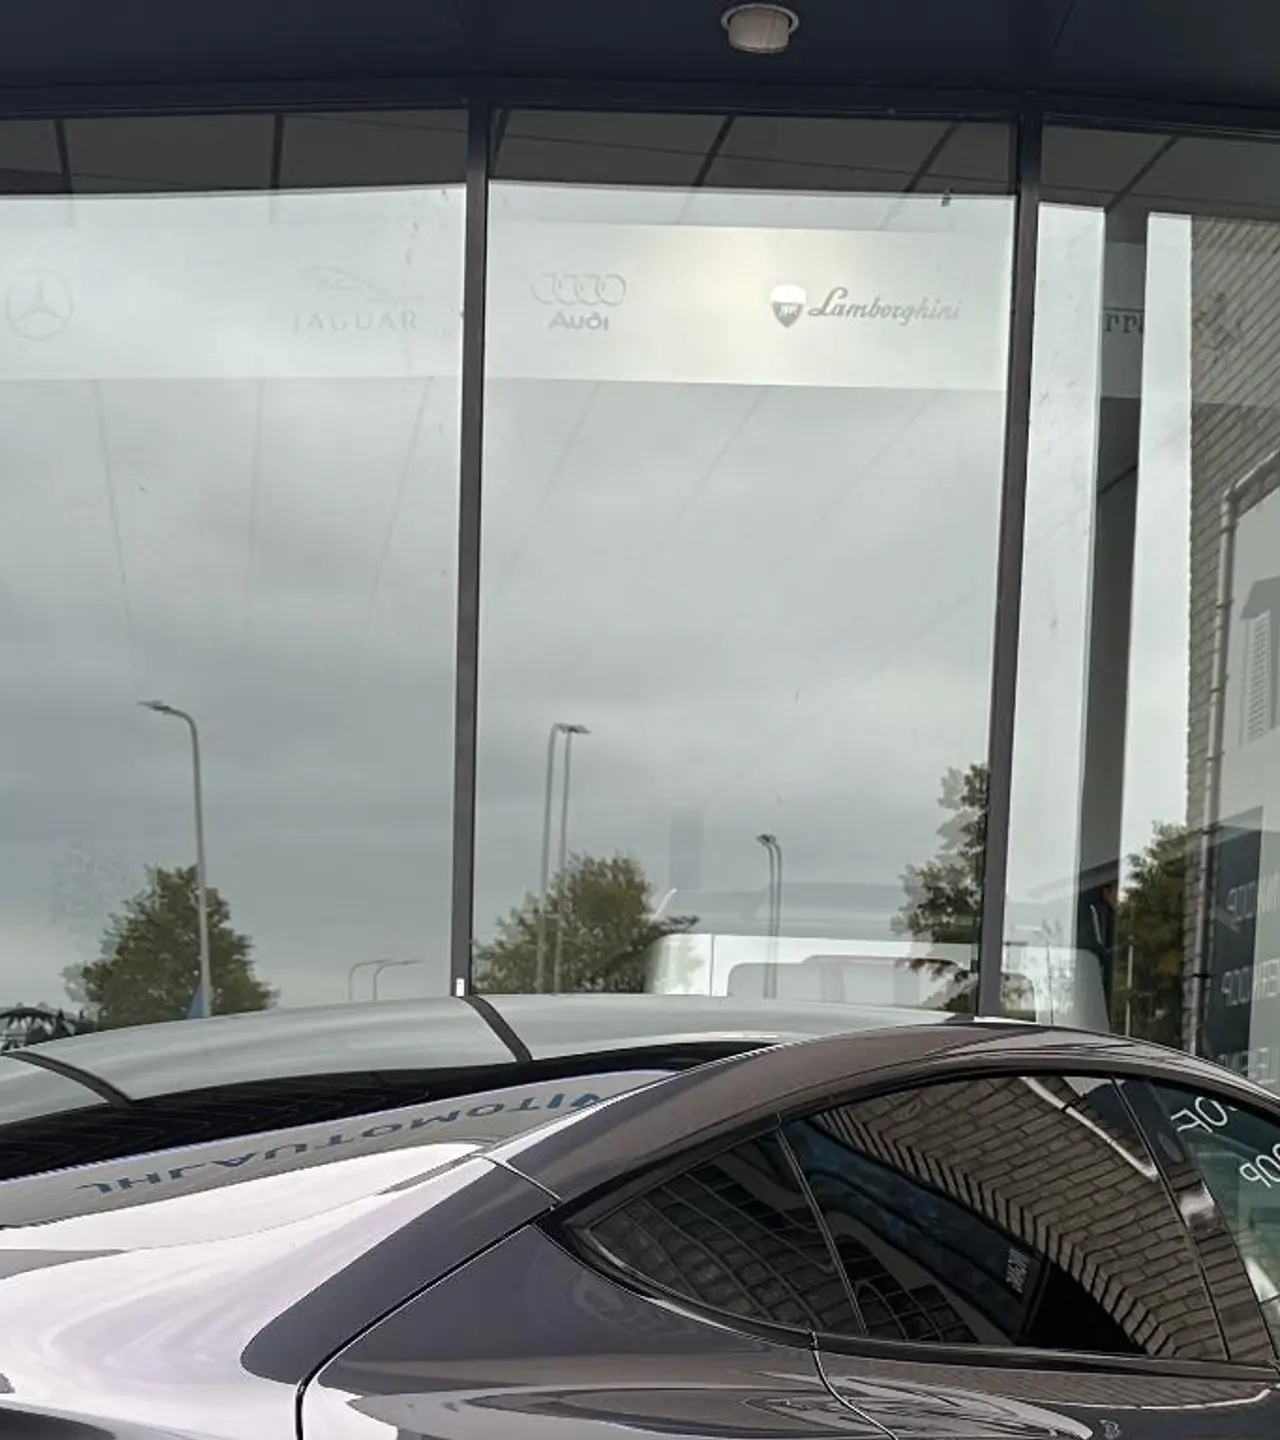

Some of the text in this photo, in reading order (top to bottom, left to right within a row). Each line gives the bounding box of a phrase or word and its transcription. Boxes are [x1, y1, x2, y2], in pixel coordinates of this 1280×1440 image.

[807, 285, 963, 327] Lamborghini
[291, 308, 418, 335] JAGUAR
[547, 310, 609, 331] Audi
